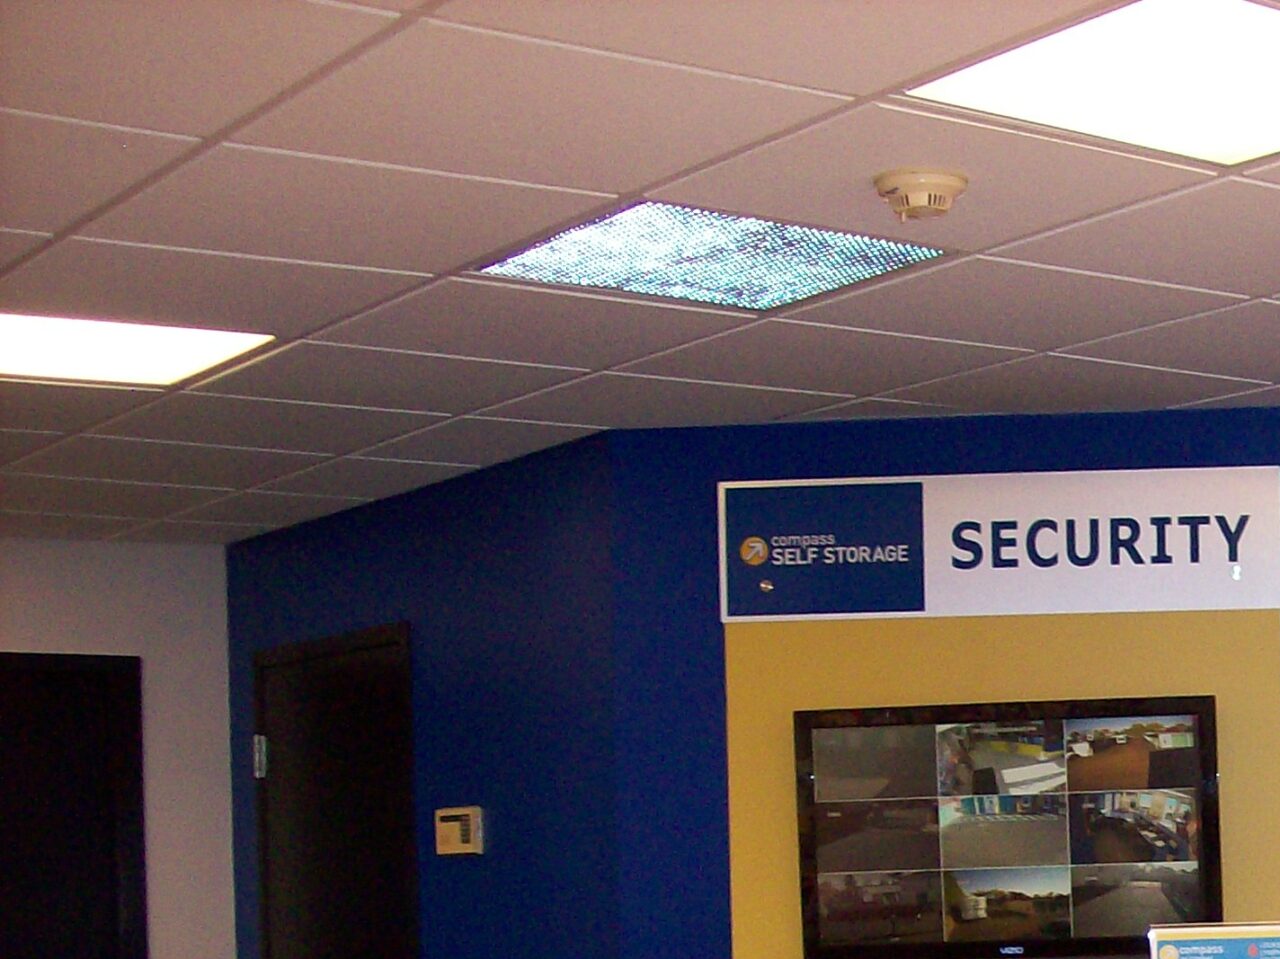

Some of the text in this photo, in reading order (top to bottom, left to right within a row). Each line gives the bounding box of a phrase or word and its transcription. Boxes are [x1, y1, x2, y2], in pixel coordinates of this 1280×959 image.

[771, 534, 835, 549] compass
[951, 514, 1250, 570] SECURITY
[771, 545, 909, 566] SELF STORAGE
